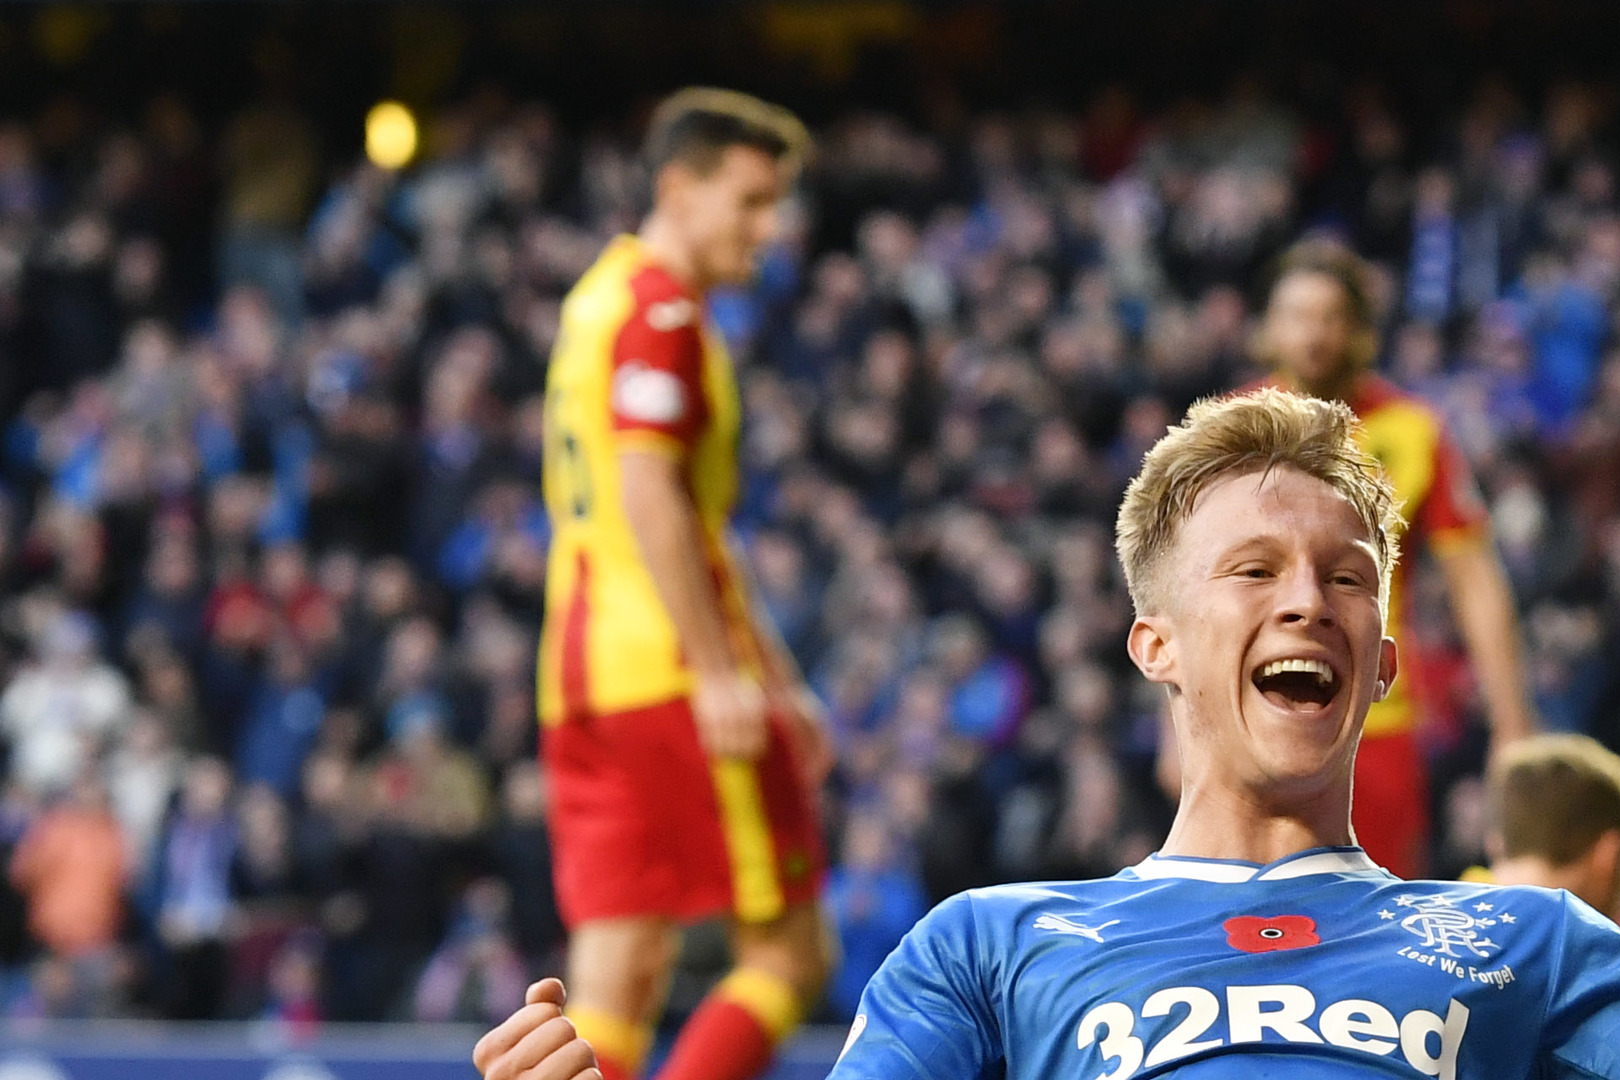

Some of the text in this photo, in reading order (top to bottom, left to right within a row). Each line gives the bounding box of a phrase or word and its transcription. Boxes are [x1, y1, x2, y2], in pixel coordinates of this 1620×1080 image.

[1397, 946, 1516, 990] Lest We Forget
